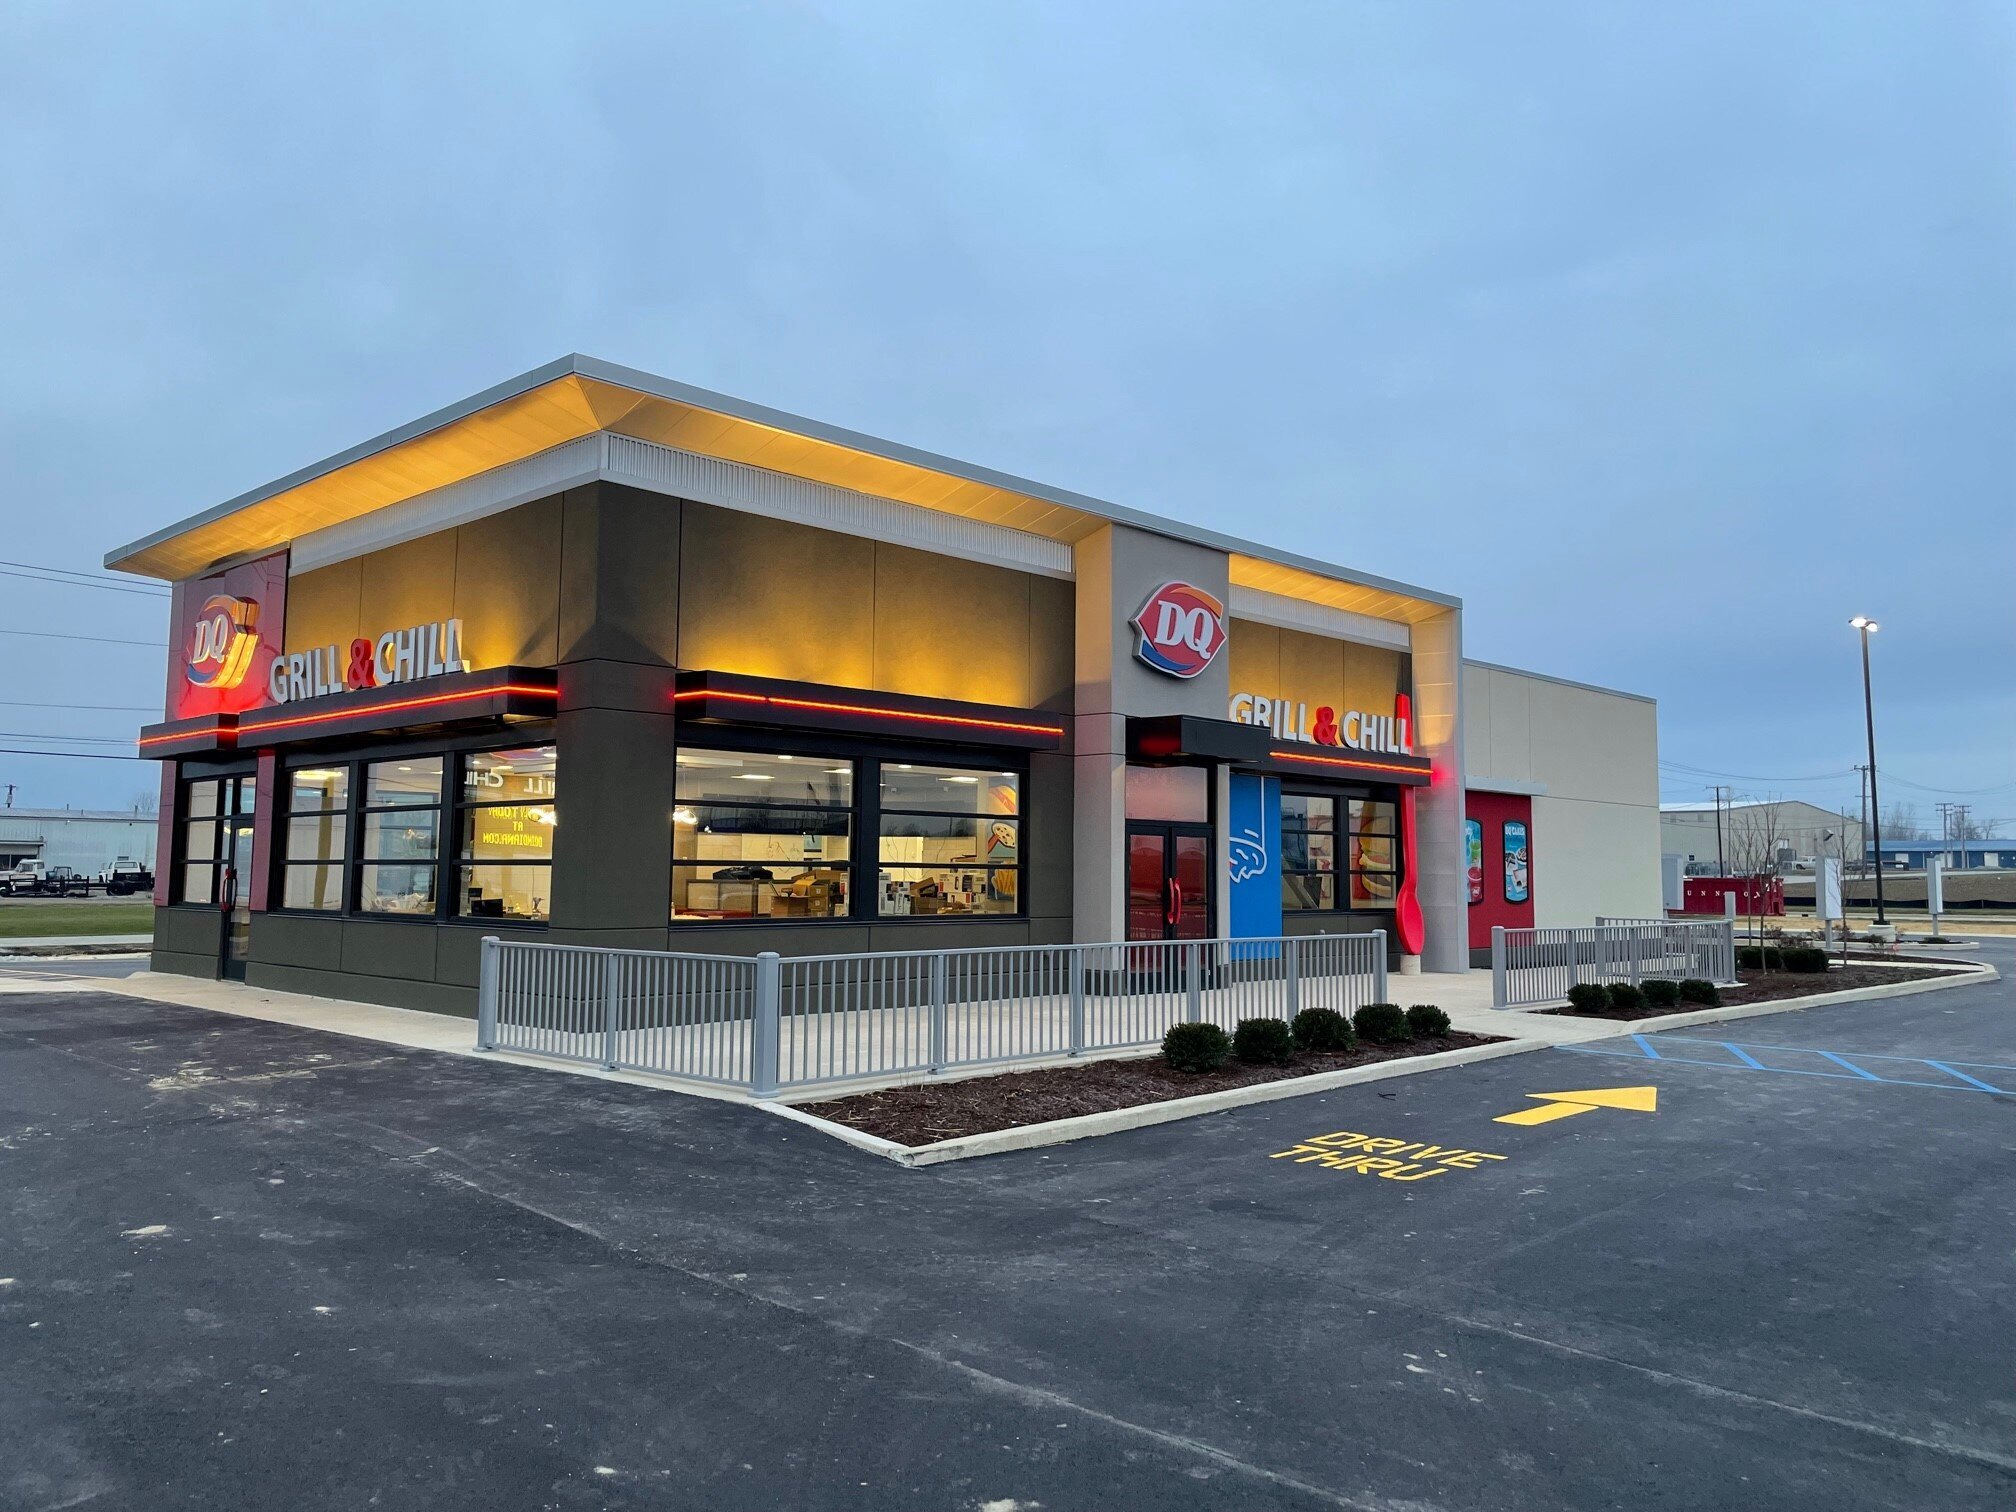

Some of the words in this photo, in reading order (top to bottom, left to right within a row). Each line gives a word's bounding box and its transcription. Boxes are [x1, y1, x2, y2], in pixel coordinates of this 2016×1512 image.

[192, 614, 229, 664] DQ
[1154, 600, 1214, 660] DQ
[269, 644, 343, 704] GRILL
[346, 638, 375, 691] &
[374, 618, 469, 686] CHILL
[1230, 693, 1312, 741] GRILL
[1313, 706, 1338, 747] &
[1340, 710, 1410, 756] CHILL
[1269, 1144, 1449, 1181] THRU
[1304, 1131, 1509, 1168] DRIVE
